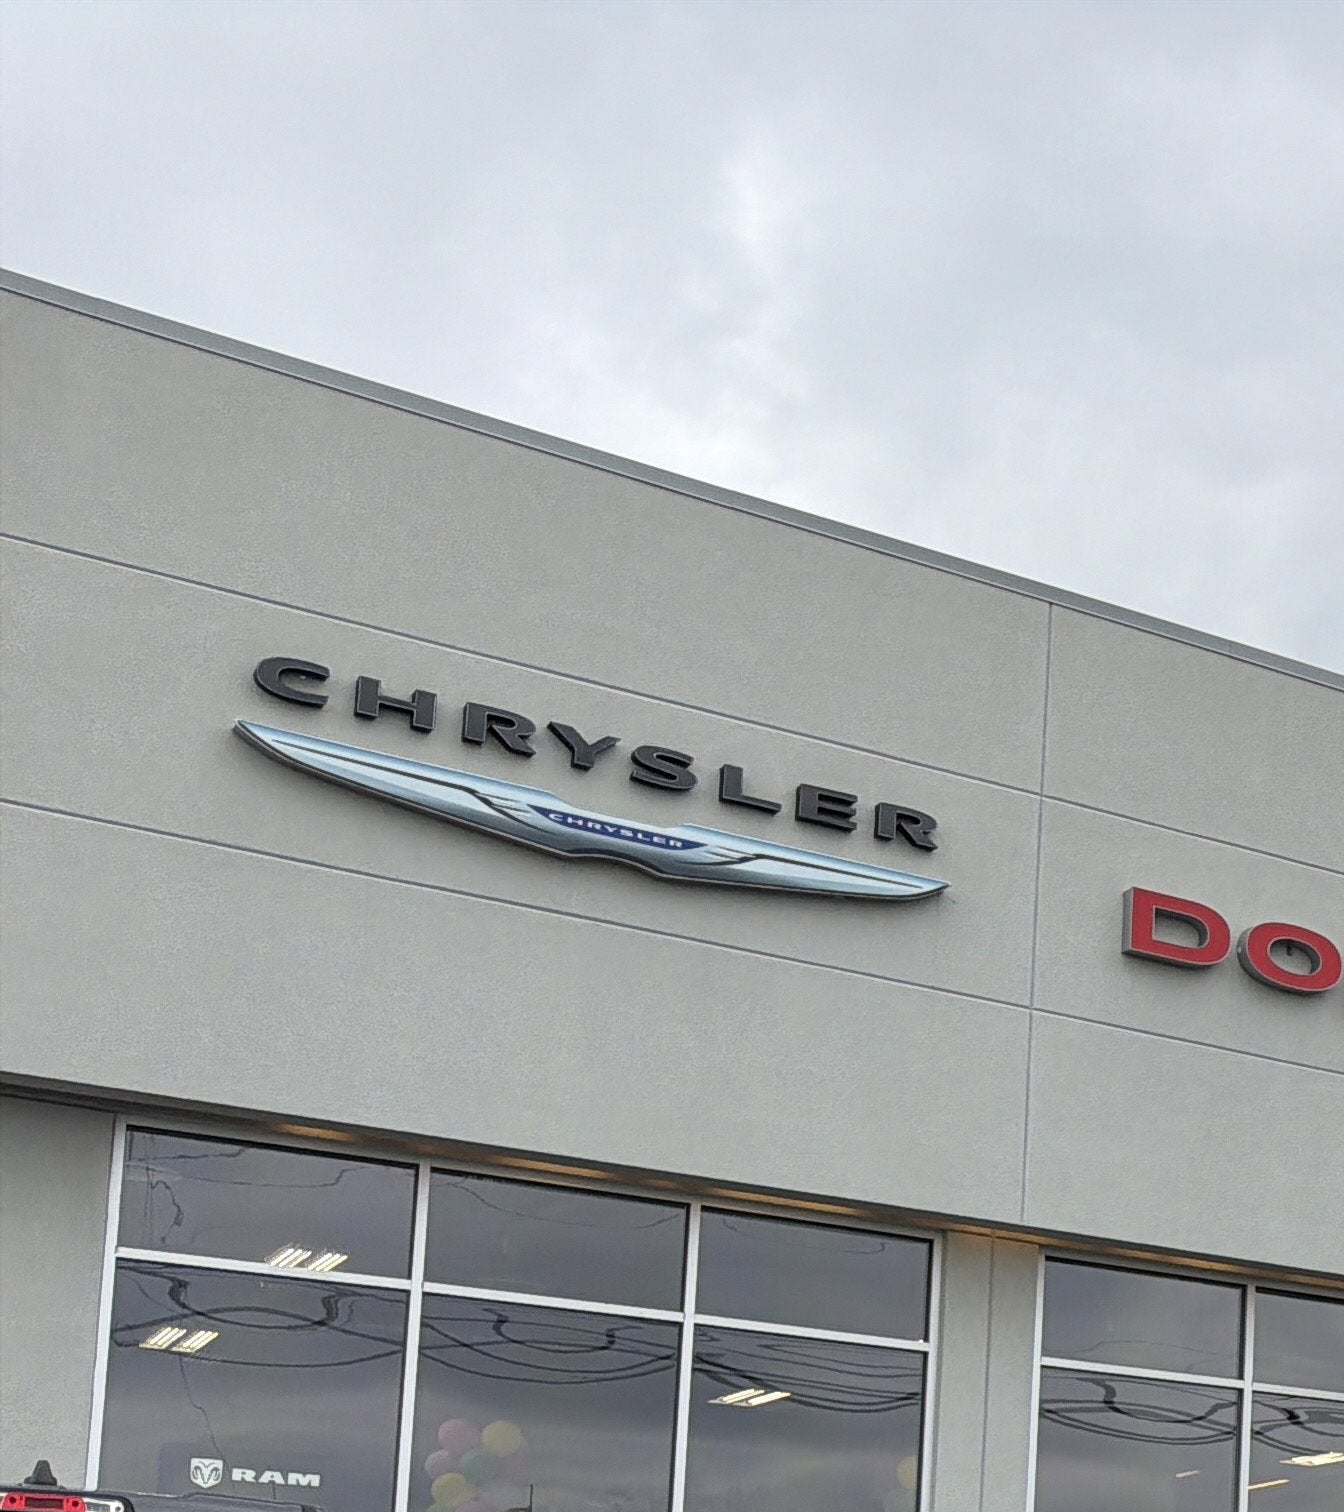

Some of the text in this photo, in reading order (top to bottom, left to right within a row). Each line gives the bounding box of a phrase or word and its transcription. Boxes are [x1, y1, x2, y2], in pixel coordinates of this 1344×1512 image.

[253, 656, 939, 852] CHRYSLER
[549, 813, 683, 848] CHRYSLER
[231, 1467, 321, 1488] RAM
